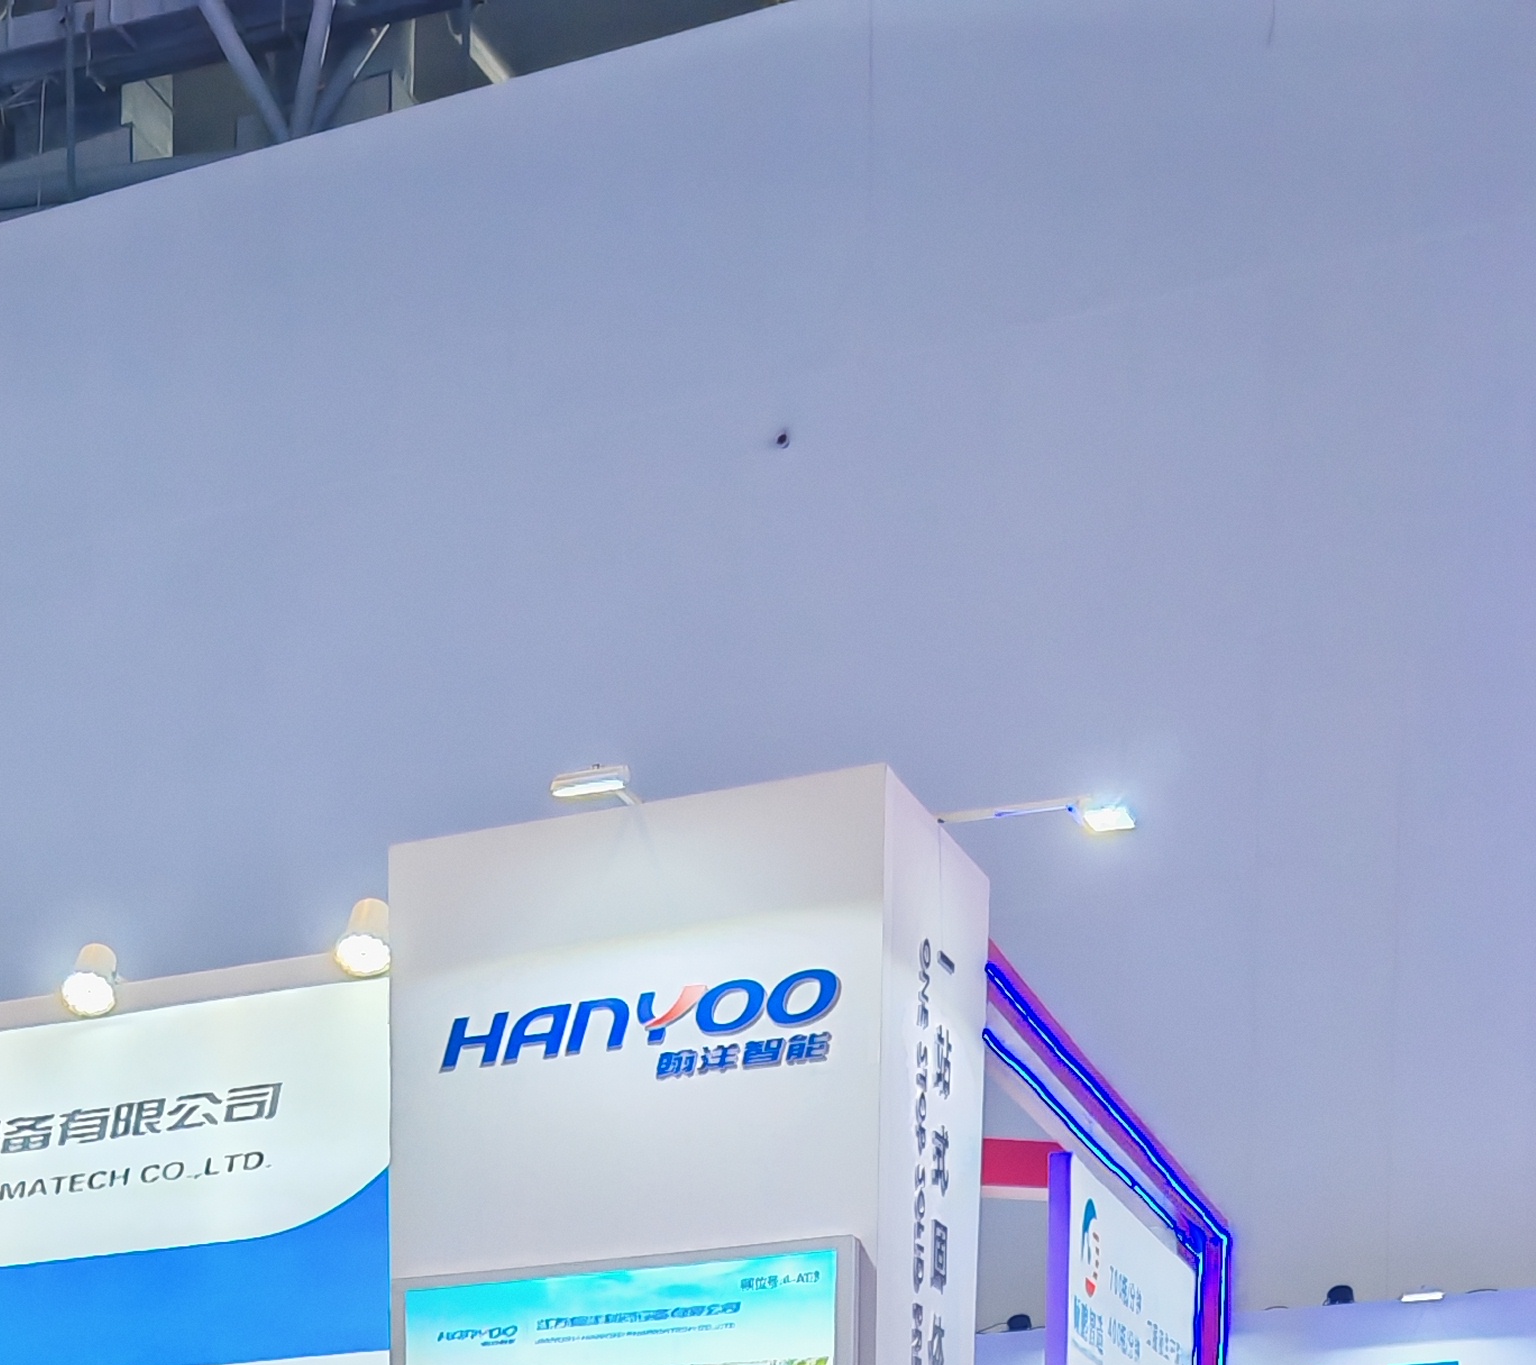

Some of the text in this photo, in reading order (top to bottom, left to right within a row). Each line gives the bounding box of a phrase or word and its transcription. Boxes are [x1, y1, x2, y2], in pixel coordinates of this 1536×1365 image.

[438, 968, 842, 1073] HANYOO
[917, 938, 931, 1030] ONE
[914, 1041, 928, 1156] STOP
[912, 1164, 926, 1293] SOLID
